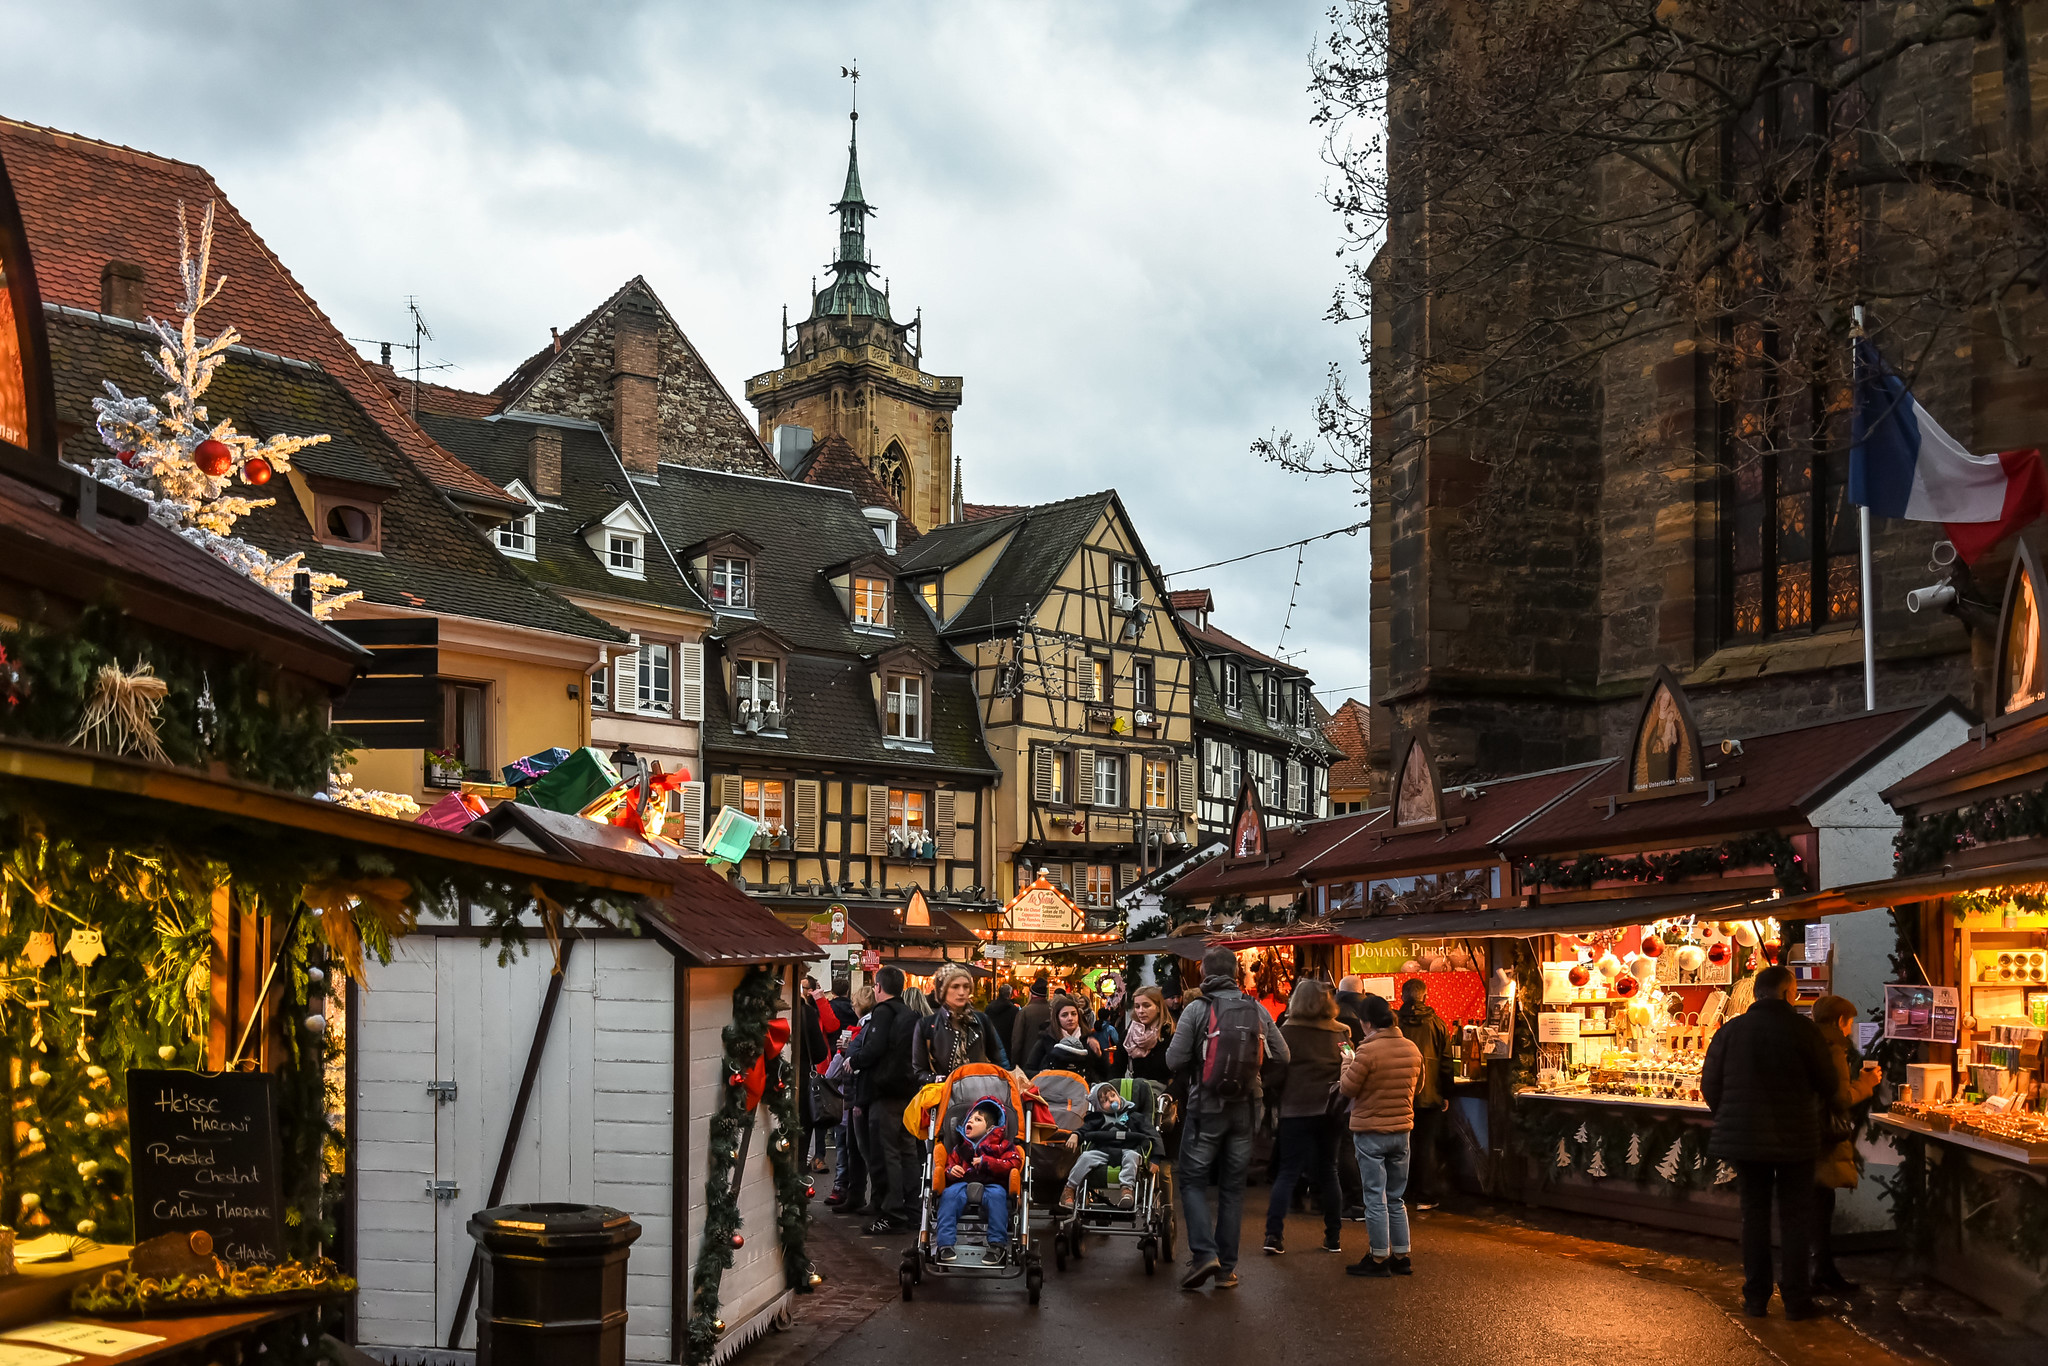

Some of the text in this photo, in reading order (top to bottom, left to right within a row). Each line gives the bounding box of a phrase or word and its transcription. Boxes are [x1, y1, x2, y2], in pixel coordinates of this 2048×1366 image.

[1355, 943, 1408, 958] DOMAINE
[1411, 942, 1452, 958] PIERRE
[155, 1088, 221, 1113] Heisse
[195, 1165, 262, 1185] Chestnut
